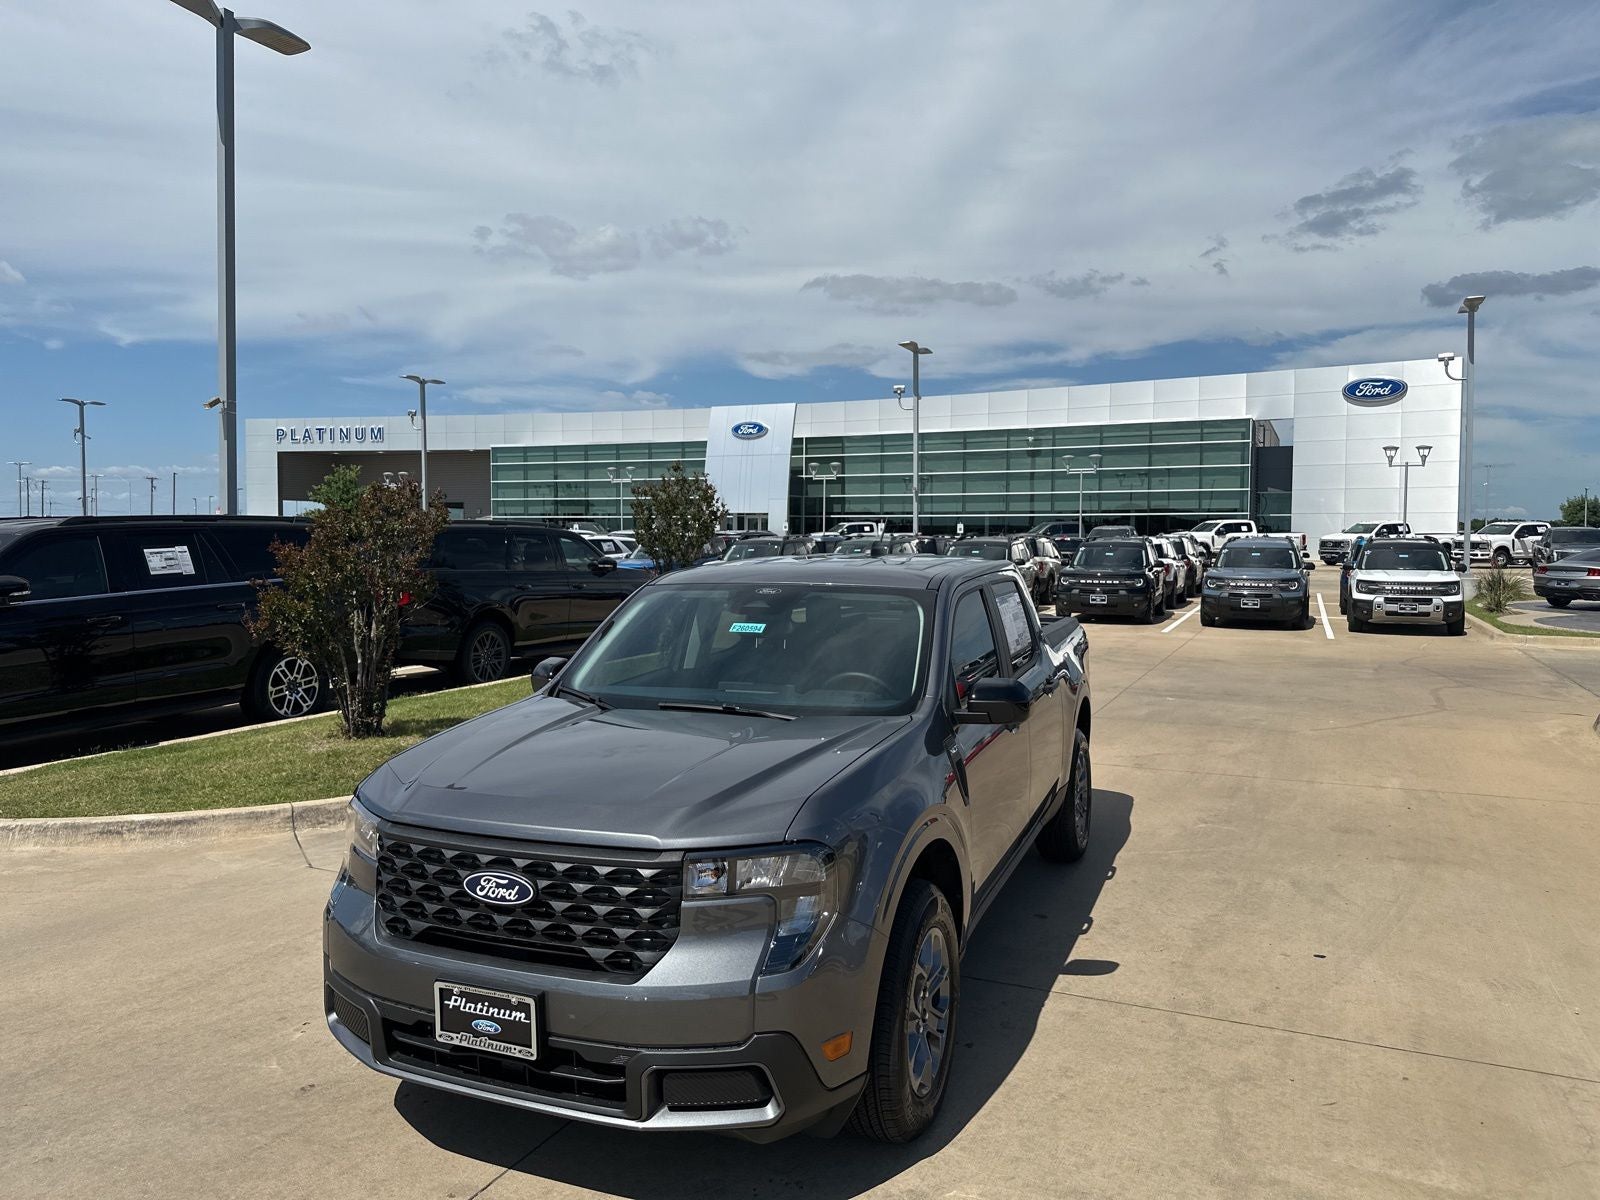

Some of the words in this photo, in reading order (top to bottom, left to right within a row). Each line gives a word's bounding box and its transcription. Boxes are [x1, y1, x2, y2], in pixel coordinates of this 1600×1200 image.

[1355, 381, 1393, 396] Ford
[276, 425, 386, 443] PLATINUM
[737, 424, 759, 434] Ford
[476, 876, 519, 901] Ford
[444, 995, 531, 1023] Platinum
[459, 1033, 517, 1056] Platinum
